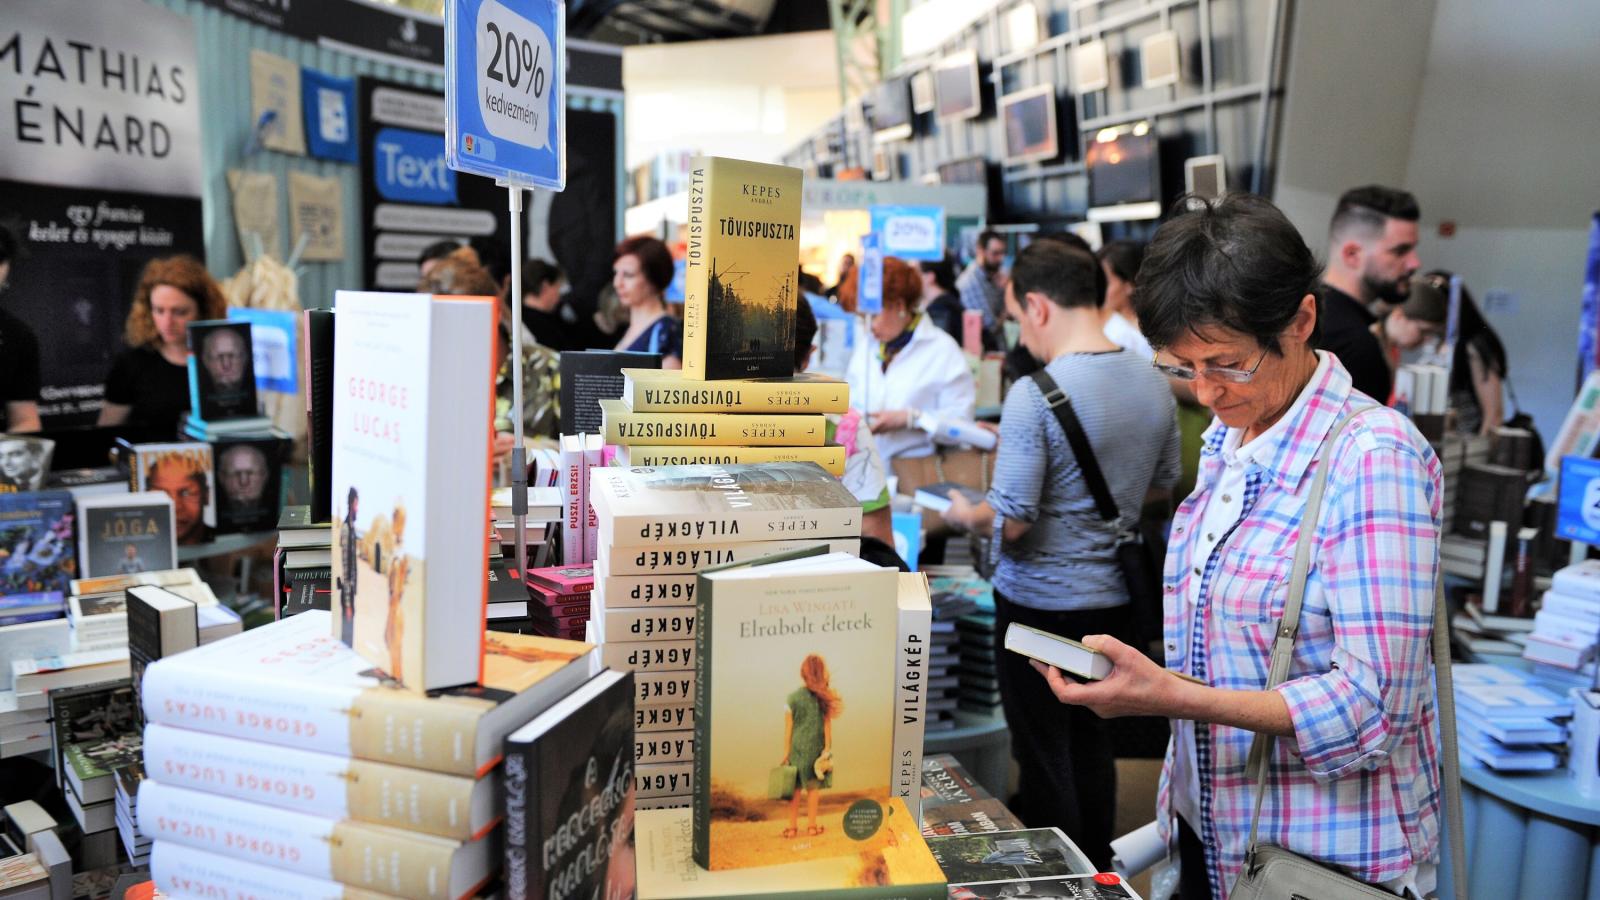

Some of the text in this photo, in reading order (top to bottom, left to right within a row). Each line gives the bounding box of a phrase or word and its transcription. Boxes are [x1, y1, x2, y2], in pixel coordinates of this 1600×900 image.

[487, 22, 544, 98] 20%
[485, 87, 538, 131] kedvezmény
[14, 85, 171, 158] ÉNARD
[379, 143, 448, 190] Text
[743, 184, 780, 198] KEPES
[720, 217, 794, 240] TÖVISPUSZTA
[688, 169, 704, 338] KEPES TÖVISPUSZTA
[349, 376, 408, 410] GEORGE
[645, 390, 810, 407] TÖVISPUSZTA KEPES
[354, 412, 401, 443] LUCAS
[619, 423, 785, 440] TÖVISPUSZTA KEPES
[570, 465, 578, 495] ERZSI!
[570, 499, 580, 529] PUSZI,
[641, 520, 818, 541] VILÁGKÉP KEPES
[636, 550, 734, 569] VILÁGKÉP
[631, 584, 694, 602] ÁGKÉP
[631, 617, 694, 636] ÁGKÉP
[740, 612, 872, 638] Elrabolt életek
[628, 648, 691, 667] ÁGKÉP
[635, 680, 695, 700] ÁGKÉ
[902, 634, 922, 724] VILÁGKÉP
[636, 708, 695, 728] LÁGKÉ
[636, 740, 694, 760] LÁGKÉ
[901, 750, 912, 797] KEPES
